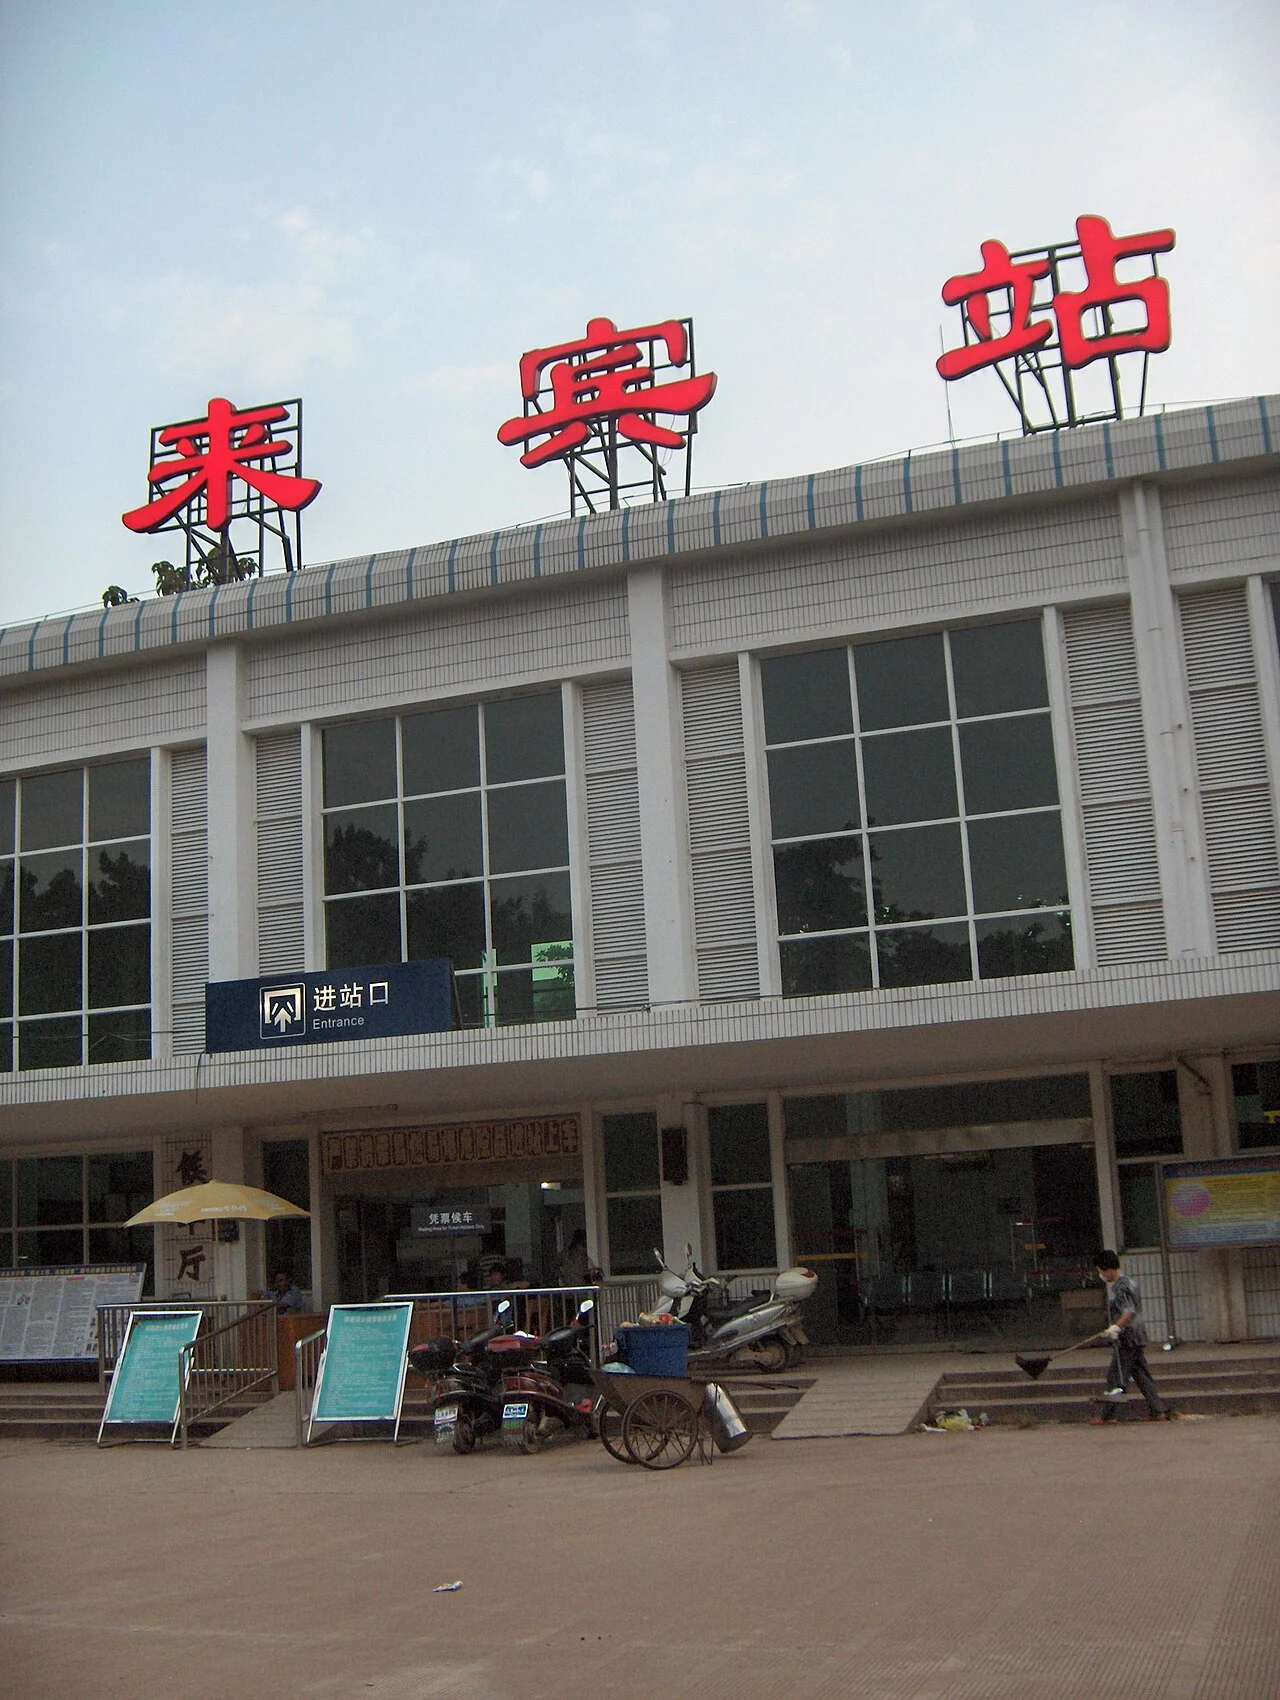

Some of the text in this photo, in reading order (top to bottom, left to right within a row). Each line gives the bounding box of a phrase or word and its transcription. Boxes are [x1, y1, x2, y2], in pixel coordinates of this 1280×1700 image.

[122, 215, 1176, 533] 来宾站
[313, 981, 390, 1012] 进站口
[312, 1015, 365, 1031] Entrance
[429, 1211, 473, 1225] 凭票候车
